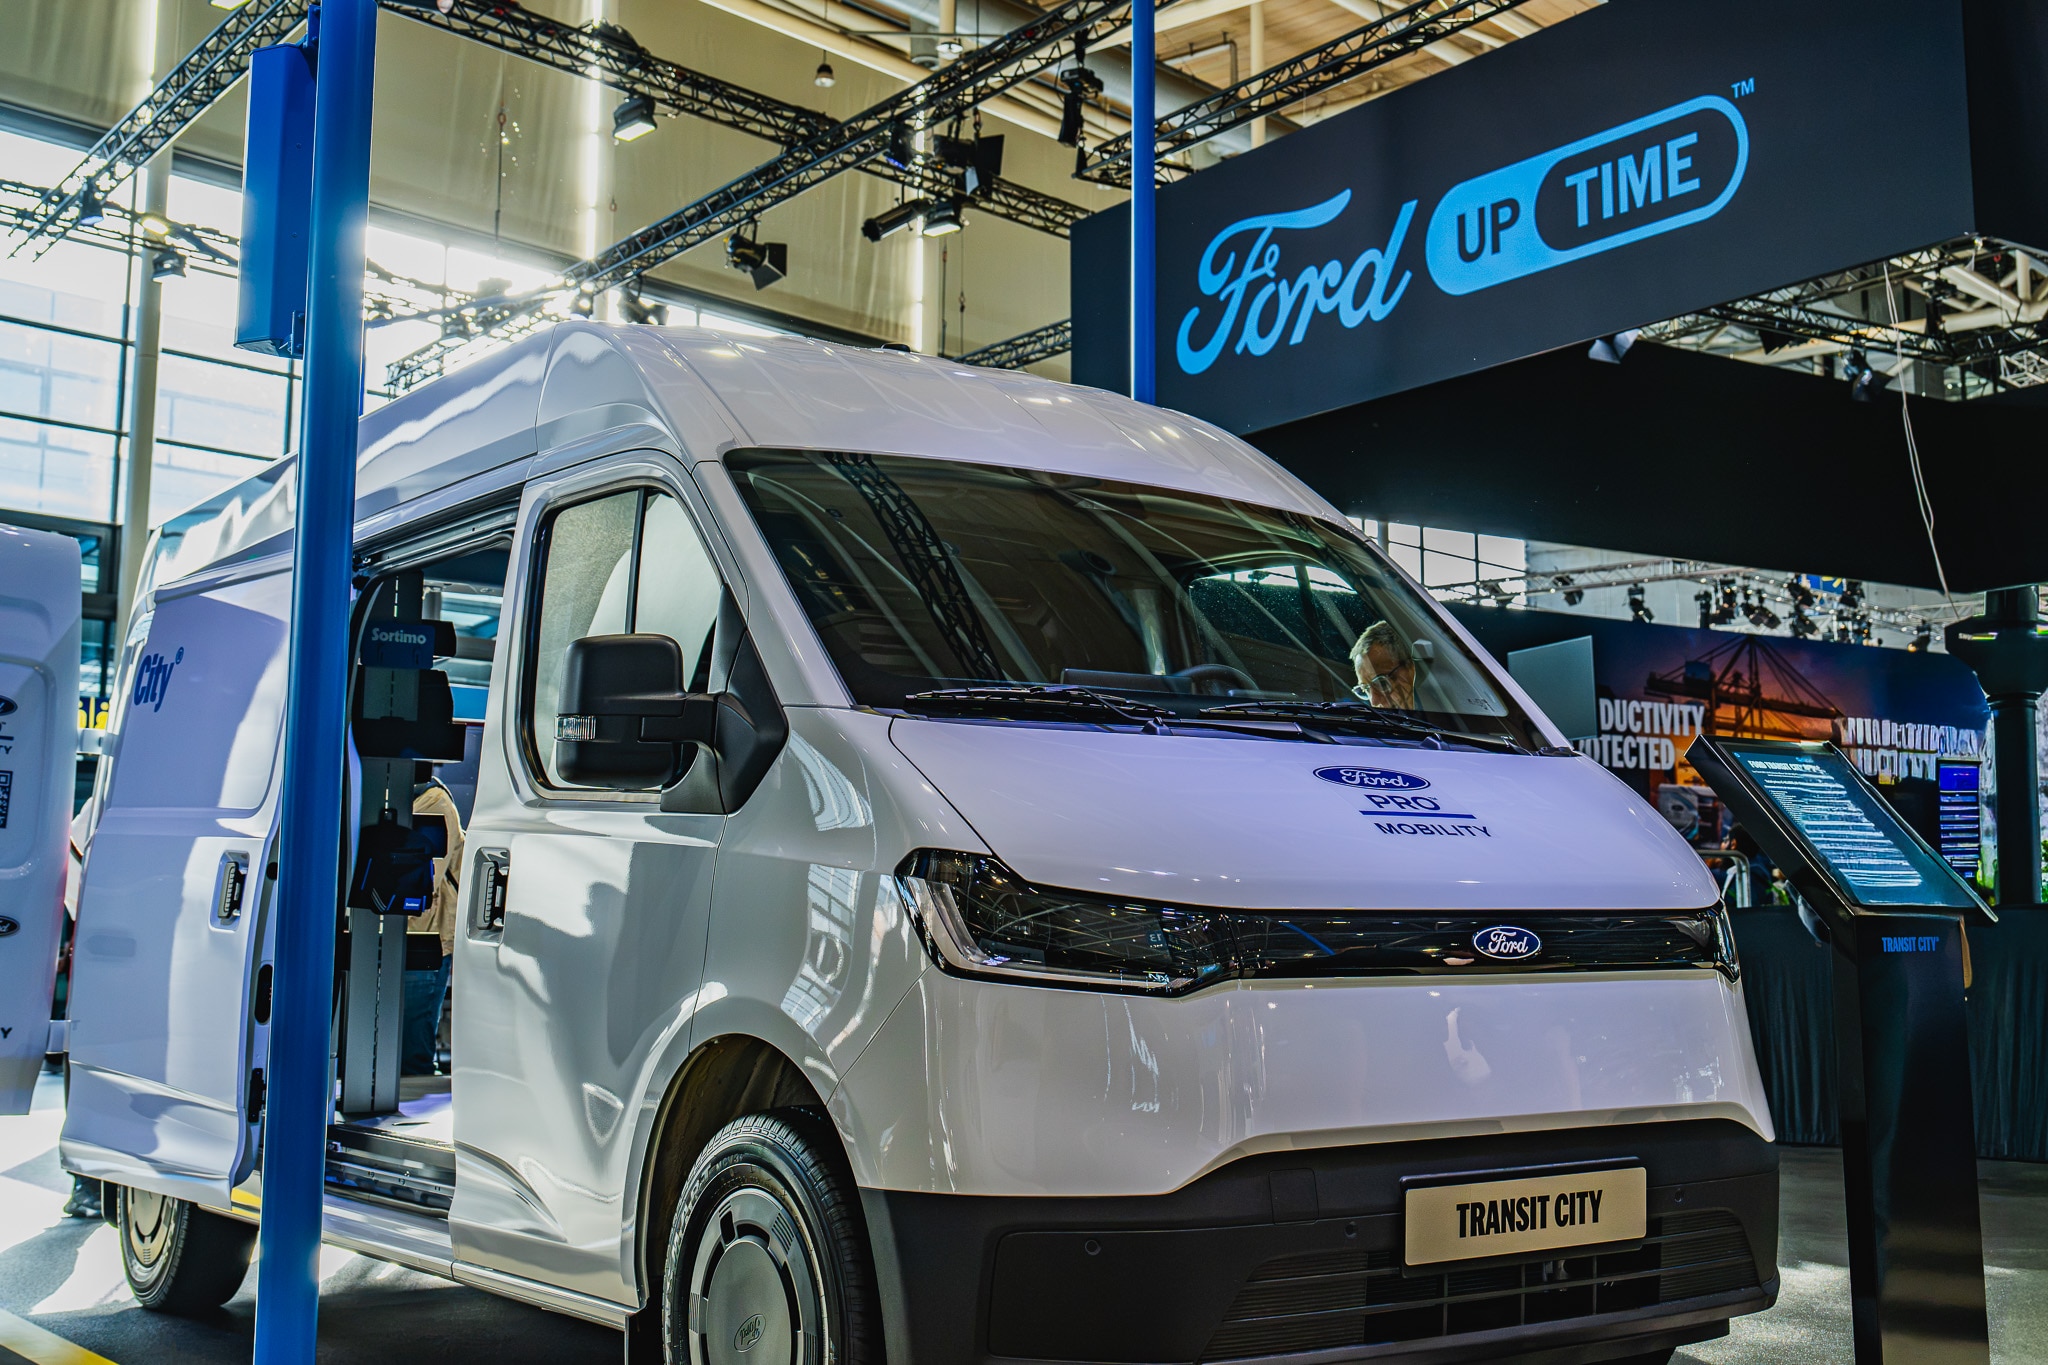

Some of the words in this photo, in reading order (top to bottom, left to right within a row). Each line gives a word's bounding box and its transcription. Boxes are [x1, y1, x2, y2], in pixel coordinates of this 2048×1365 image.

[1175, 188, 1418, 375] Ford
[1456, 197, 1520, 263] UP
[1565, 131, 1700, 227] TIME
[372, 627, 426, 645] Sortimo
[1340, 768, 1410, 788] Ford
[1364, 794, 1441, 811] PRO
[1374, 822, 1492, 838] MOBILITY
[1488, 930, 1529, 954] Ford
[1881, 936, 1917, 953] TRANSIT
[1456, 1194, 1550, 1238] TRANSIT
[1554, 1189, 1603, 1227] CITY
